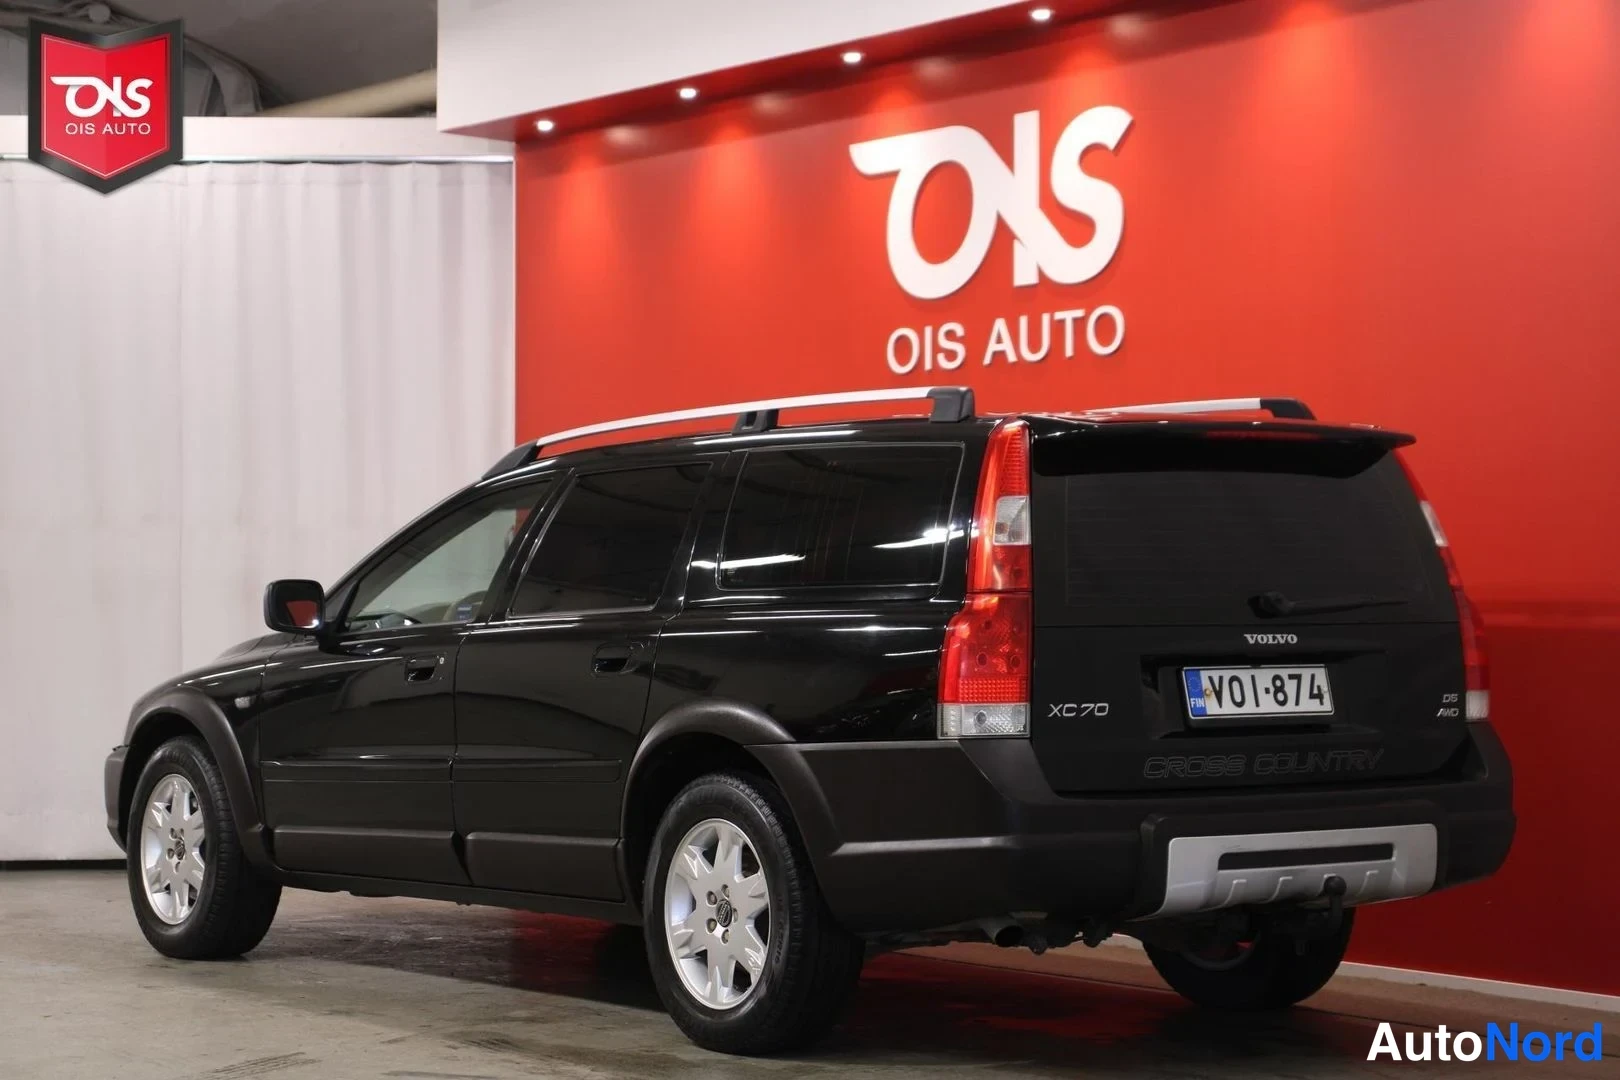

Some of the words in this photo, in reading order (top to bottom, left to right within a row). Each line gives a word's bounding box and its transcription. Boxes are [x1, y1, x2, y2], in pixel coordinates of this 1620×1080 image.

[849, 105, 1133, 300] OIS
[886, 322, 966, 374] OIS
[982, 305, 1125, 366] AUTO
[1244, 633, 1298, 644] VOLVO
[1190, 697, 1205, 708] FIN
[1436, 708, 1459, 717] AWD
[1143, 755, 1247, 778] CROSS
[1253, 748, 1384, 775] COUNTRY
